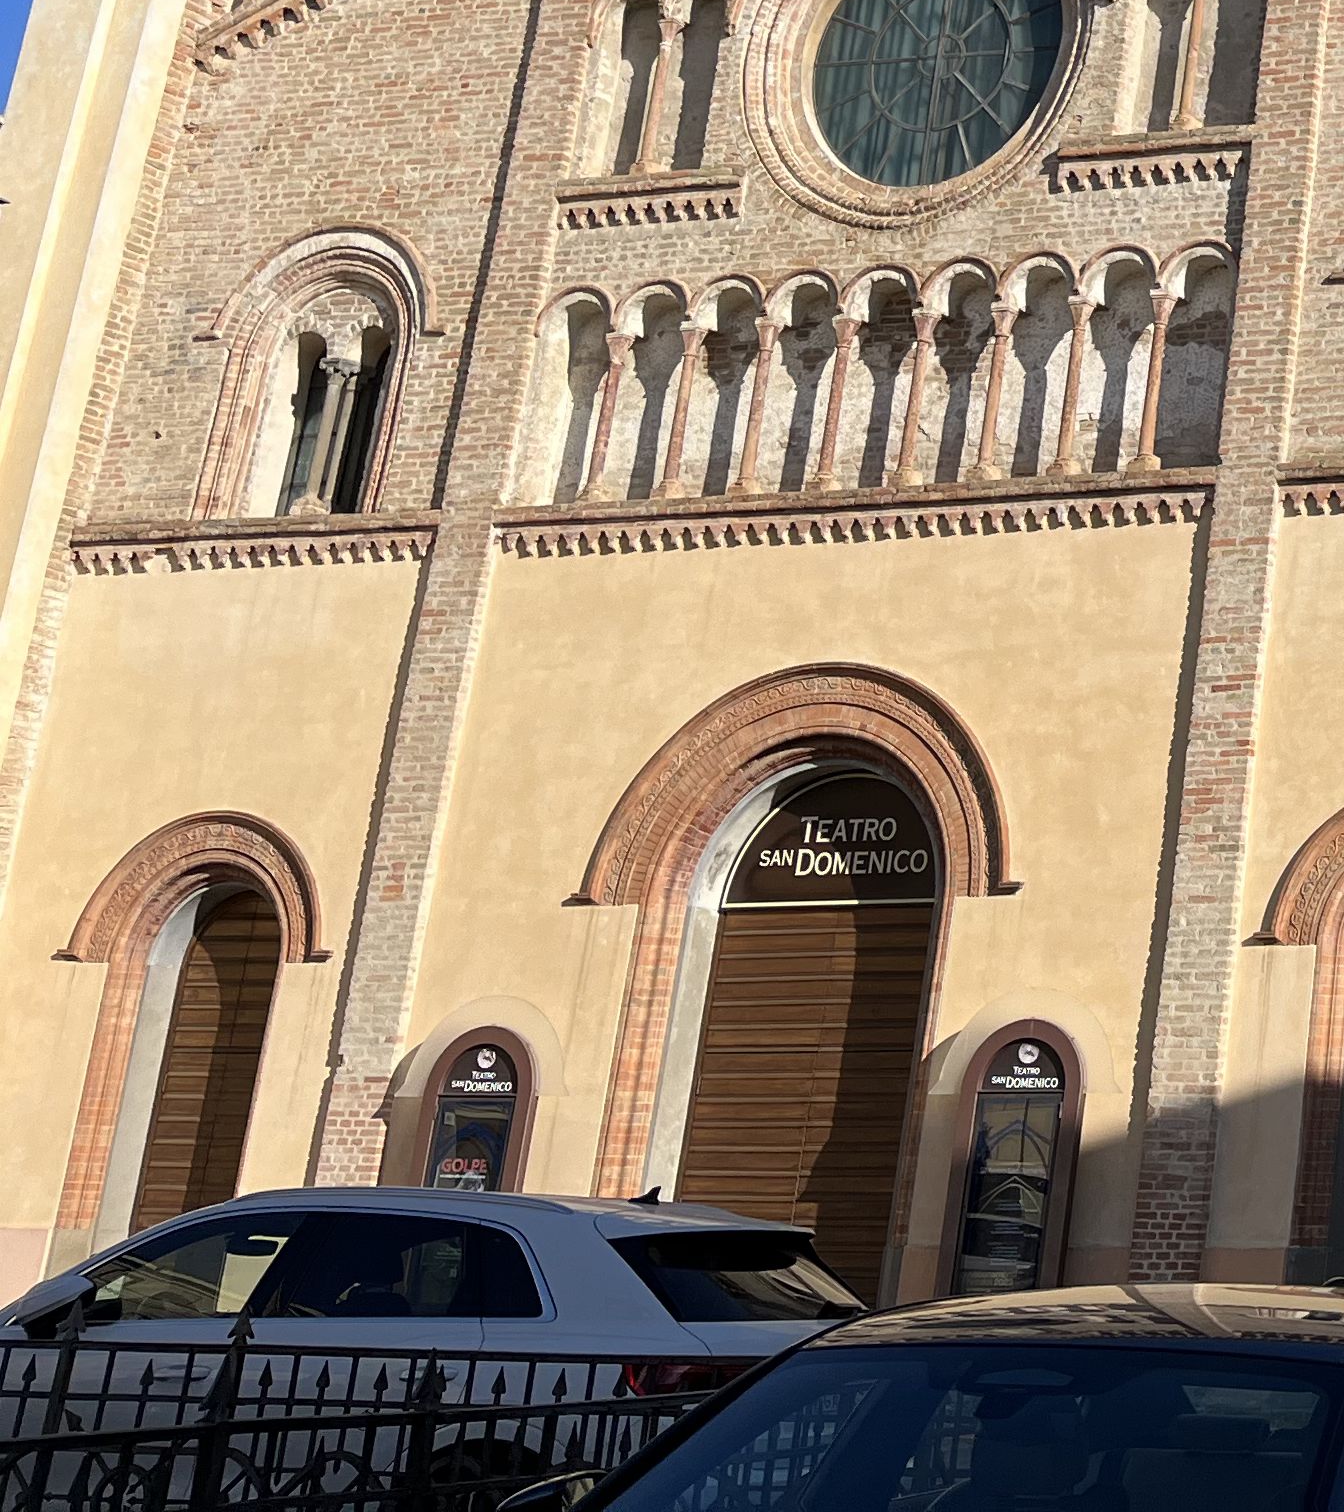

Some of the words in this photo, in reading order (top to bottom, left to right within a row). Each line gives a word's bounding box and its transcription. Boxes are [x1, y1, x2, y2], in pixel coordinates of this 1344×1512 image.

[800, 815, 897, 844] TEATRO
[758, 849, 795, 867] SAN
[794, 848, 929, 877] DOMENICO
[471, 1070, 497, 1080] TEATRO
[1012, 1065, 1041, 1076] TEATRO
[451, 1080, 465, 1089] SAN
[464, 1080, 512, 1092] DOMENICO
[991, 1076, 1006, 1085] SAN
[1005, 1076, 1059, 1089] DOMENICO
